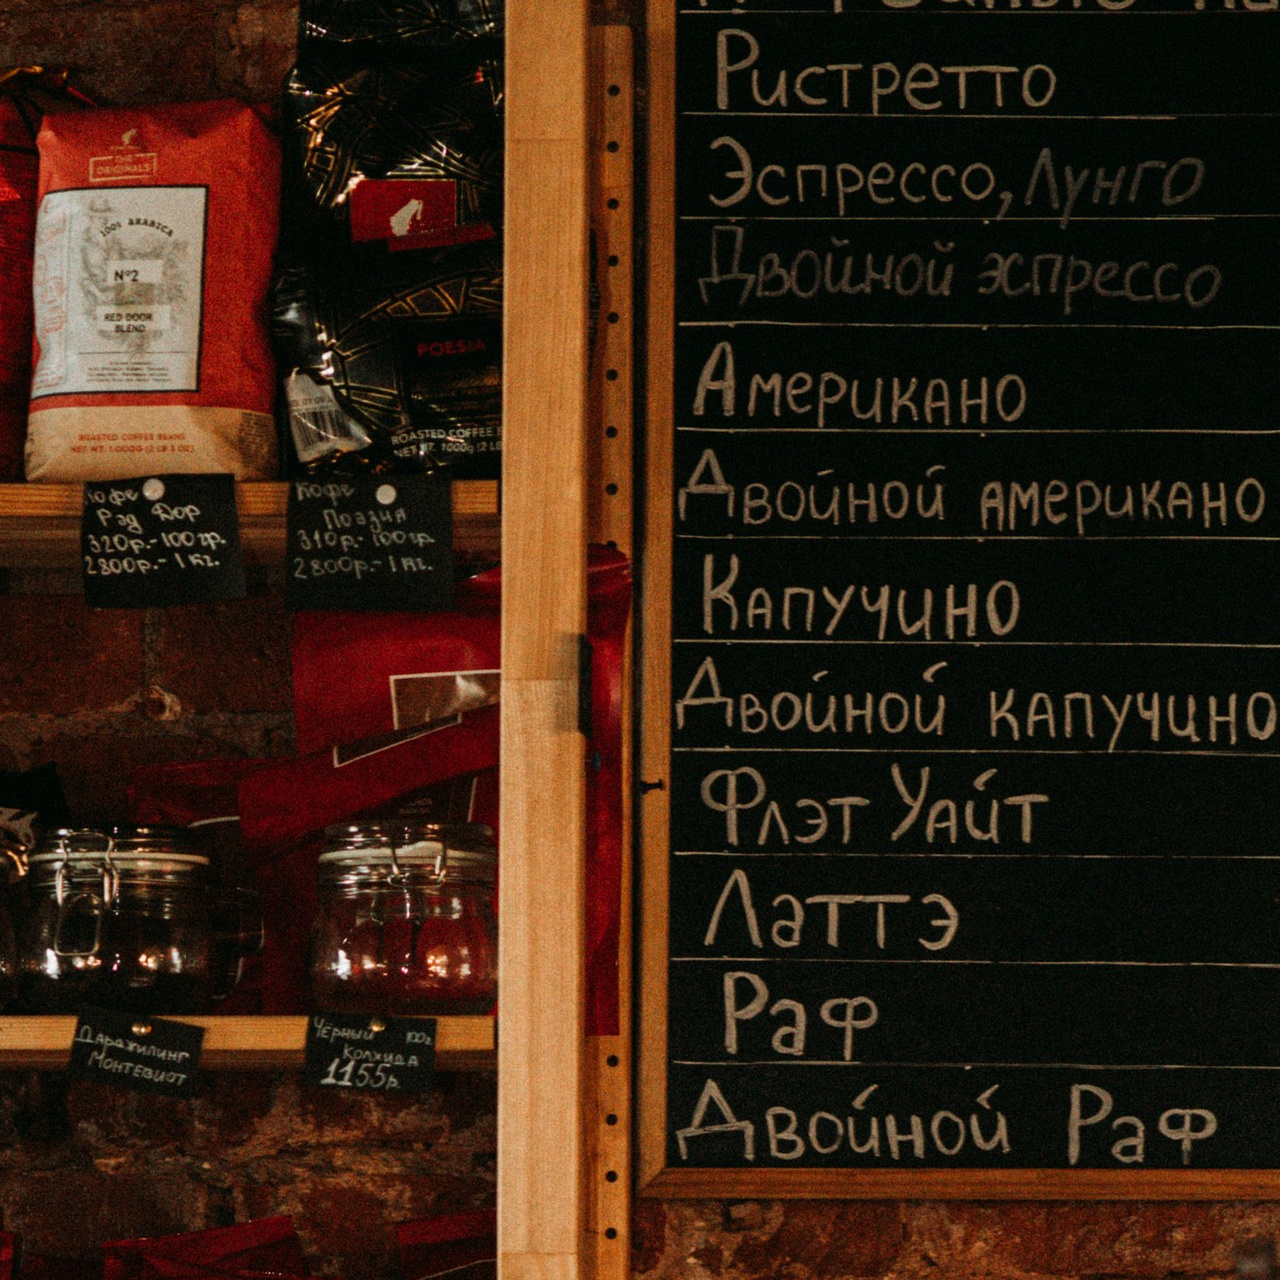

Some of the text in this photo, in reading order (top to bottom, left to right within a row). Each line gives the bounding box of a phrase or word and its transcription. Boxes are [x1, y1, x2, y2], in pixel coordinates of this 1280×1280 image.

[716, 28, 1057, 115] Ристретто
[128, 217, 174, 237] ARABICA
[1024, 147, 1206, 230] Лунго
[698, 224, 955, 306] Двойной
[104, 312, 153, 322] RED DOOR
[114, 323, 146, 333] BLEND
[416, 338, 487, 358] POESIA
[691, 341, 1027, 428] Американо
[391, 428, 446, 445] ROASTED
[296, 482, 355, 507] Кофе
[678, 448, 946, 525] Двойной
[701, 554, 1021, 640] Капучино
[675, 656, 1278, 752] Двойной капучино
[700, 763, 1050, 846] Флэт Уайт
[704, 868, 959, 951] Латтэ
[343, 1044, 419, 1066] Колхида
[723, 970, 878, 1061] Раф
[675, 1079, 1218, 1165] Двойной Раф
